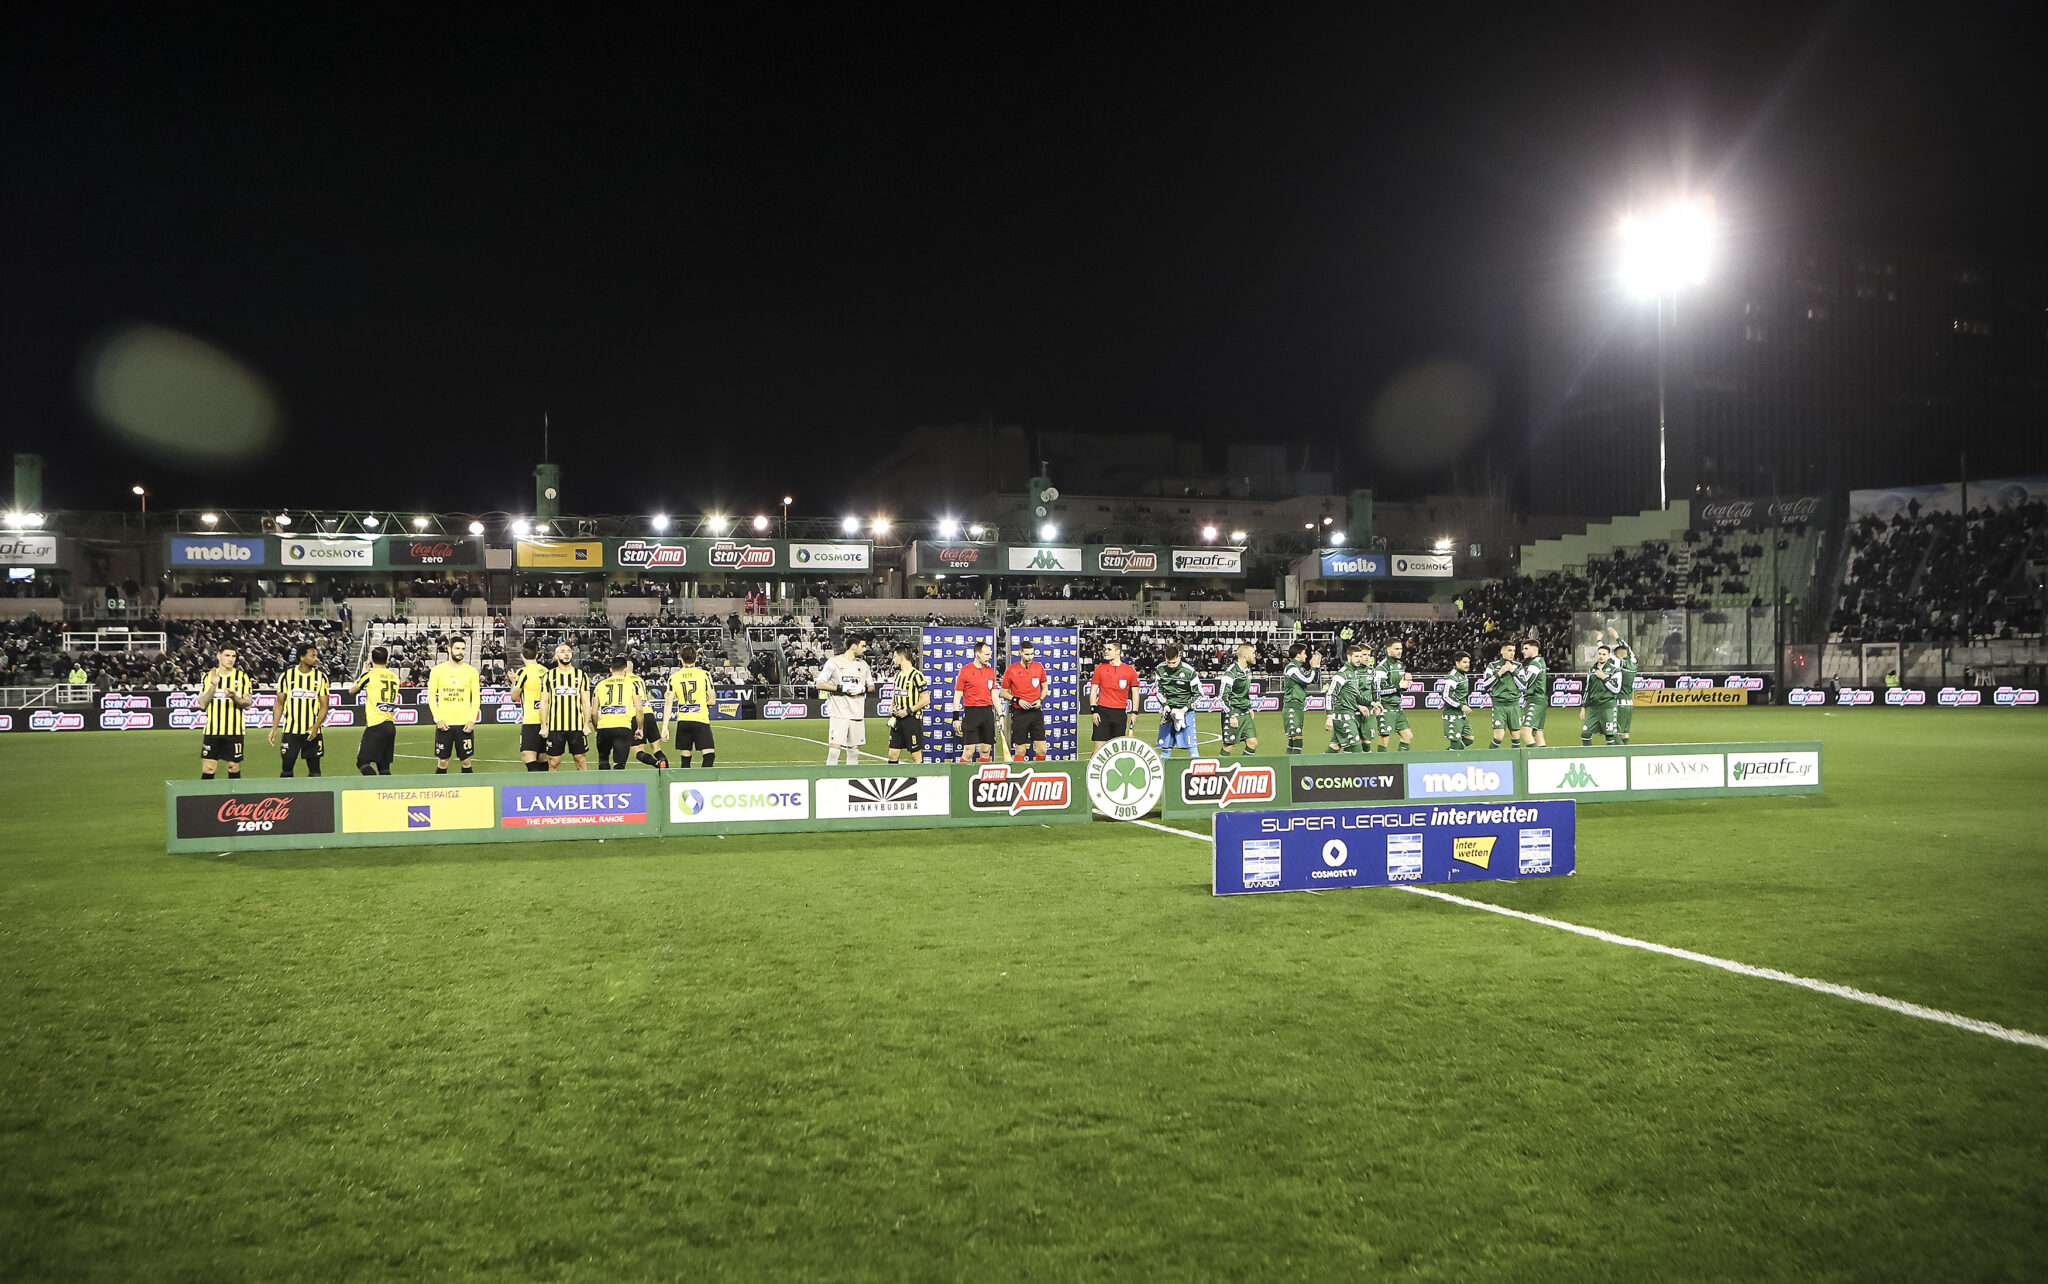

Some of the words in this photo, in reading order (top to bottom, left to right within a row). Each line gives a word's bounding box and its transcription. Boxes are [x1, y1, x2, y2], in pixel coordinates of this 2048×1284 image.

[0, 536, 52, 556] ofc.gr
[185, 542, 251, 561] molto
[310, 549, 365, 559] COSMOTE
[422, 556, 444, 564] zero
[814, 553, 862, 562] COSMOTE
[1332, 558, 1377, 573] molto
[380, 680, 397, 704] 26
[604, 684, 623, 706] 31
[680, 681, 697, 704] 12
[734, 689, 752, 700] TV
[1657, 691, 1740, 703] interwetten
[463, 739, 472, 750] 28
[982, 769, 1007, 779] pame
[1648, 762, 1709, 776] DIONYSOS
[1743, 758, 1813, 781] paofc.gr
[1315, 776, 1378, 789] COSMOTE
[1378, 775, 1394, 788] TV
[1423, 766, 1500, 793] molto
[377, 792, 417, 800] ΤΡΑΠΕΖΑ
[419, 790, 460, 799] ΠΕΙΡΑΙΩΣ
[516, 792, 631, 812] LAMBERTS
[711, 792, 802, 809] COSMOTE
[218, 797, 294, 822] Coca-Cola
[1114, 805, 1138, 818] 1908
[1261, 815, 1336, 832] SUPER
[1341, 812, 1427, 829] LEAGUE
[1431, 806, 1538, 826] interwetten
[237, 821, 273, 832] zero
[1455, 838, 1477, 849] inter
[1458, 848, 1489, 858] wetten
[1311, 870, 1347, 879] COSMOTE
[1347, 869, 1358, 877] TV
